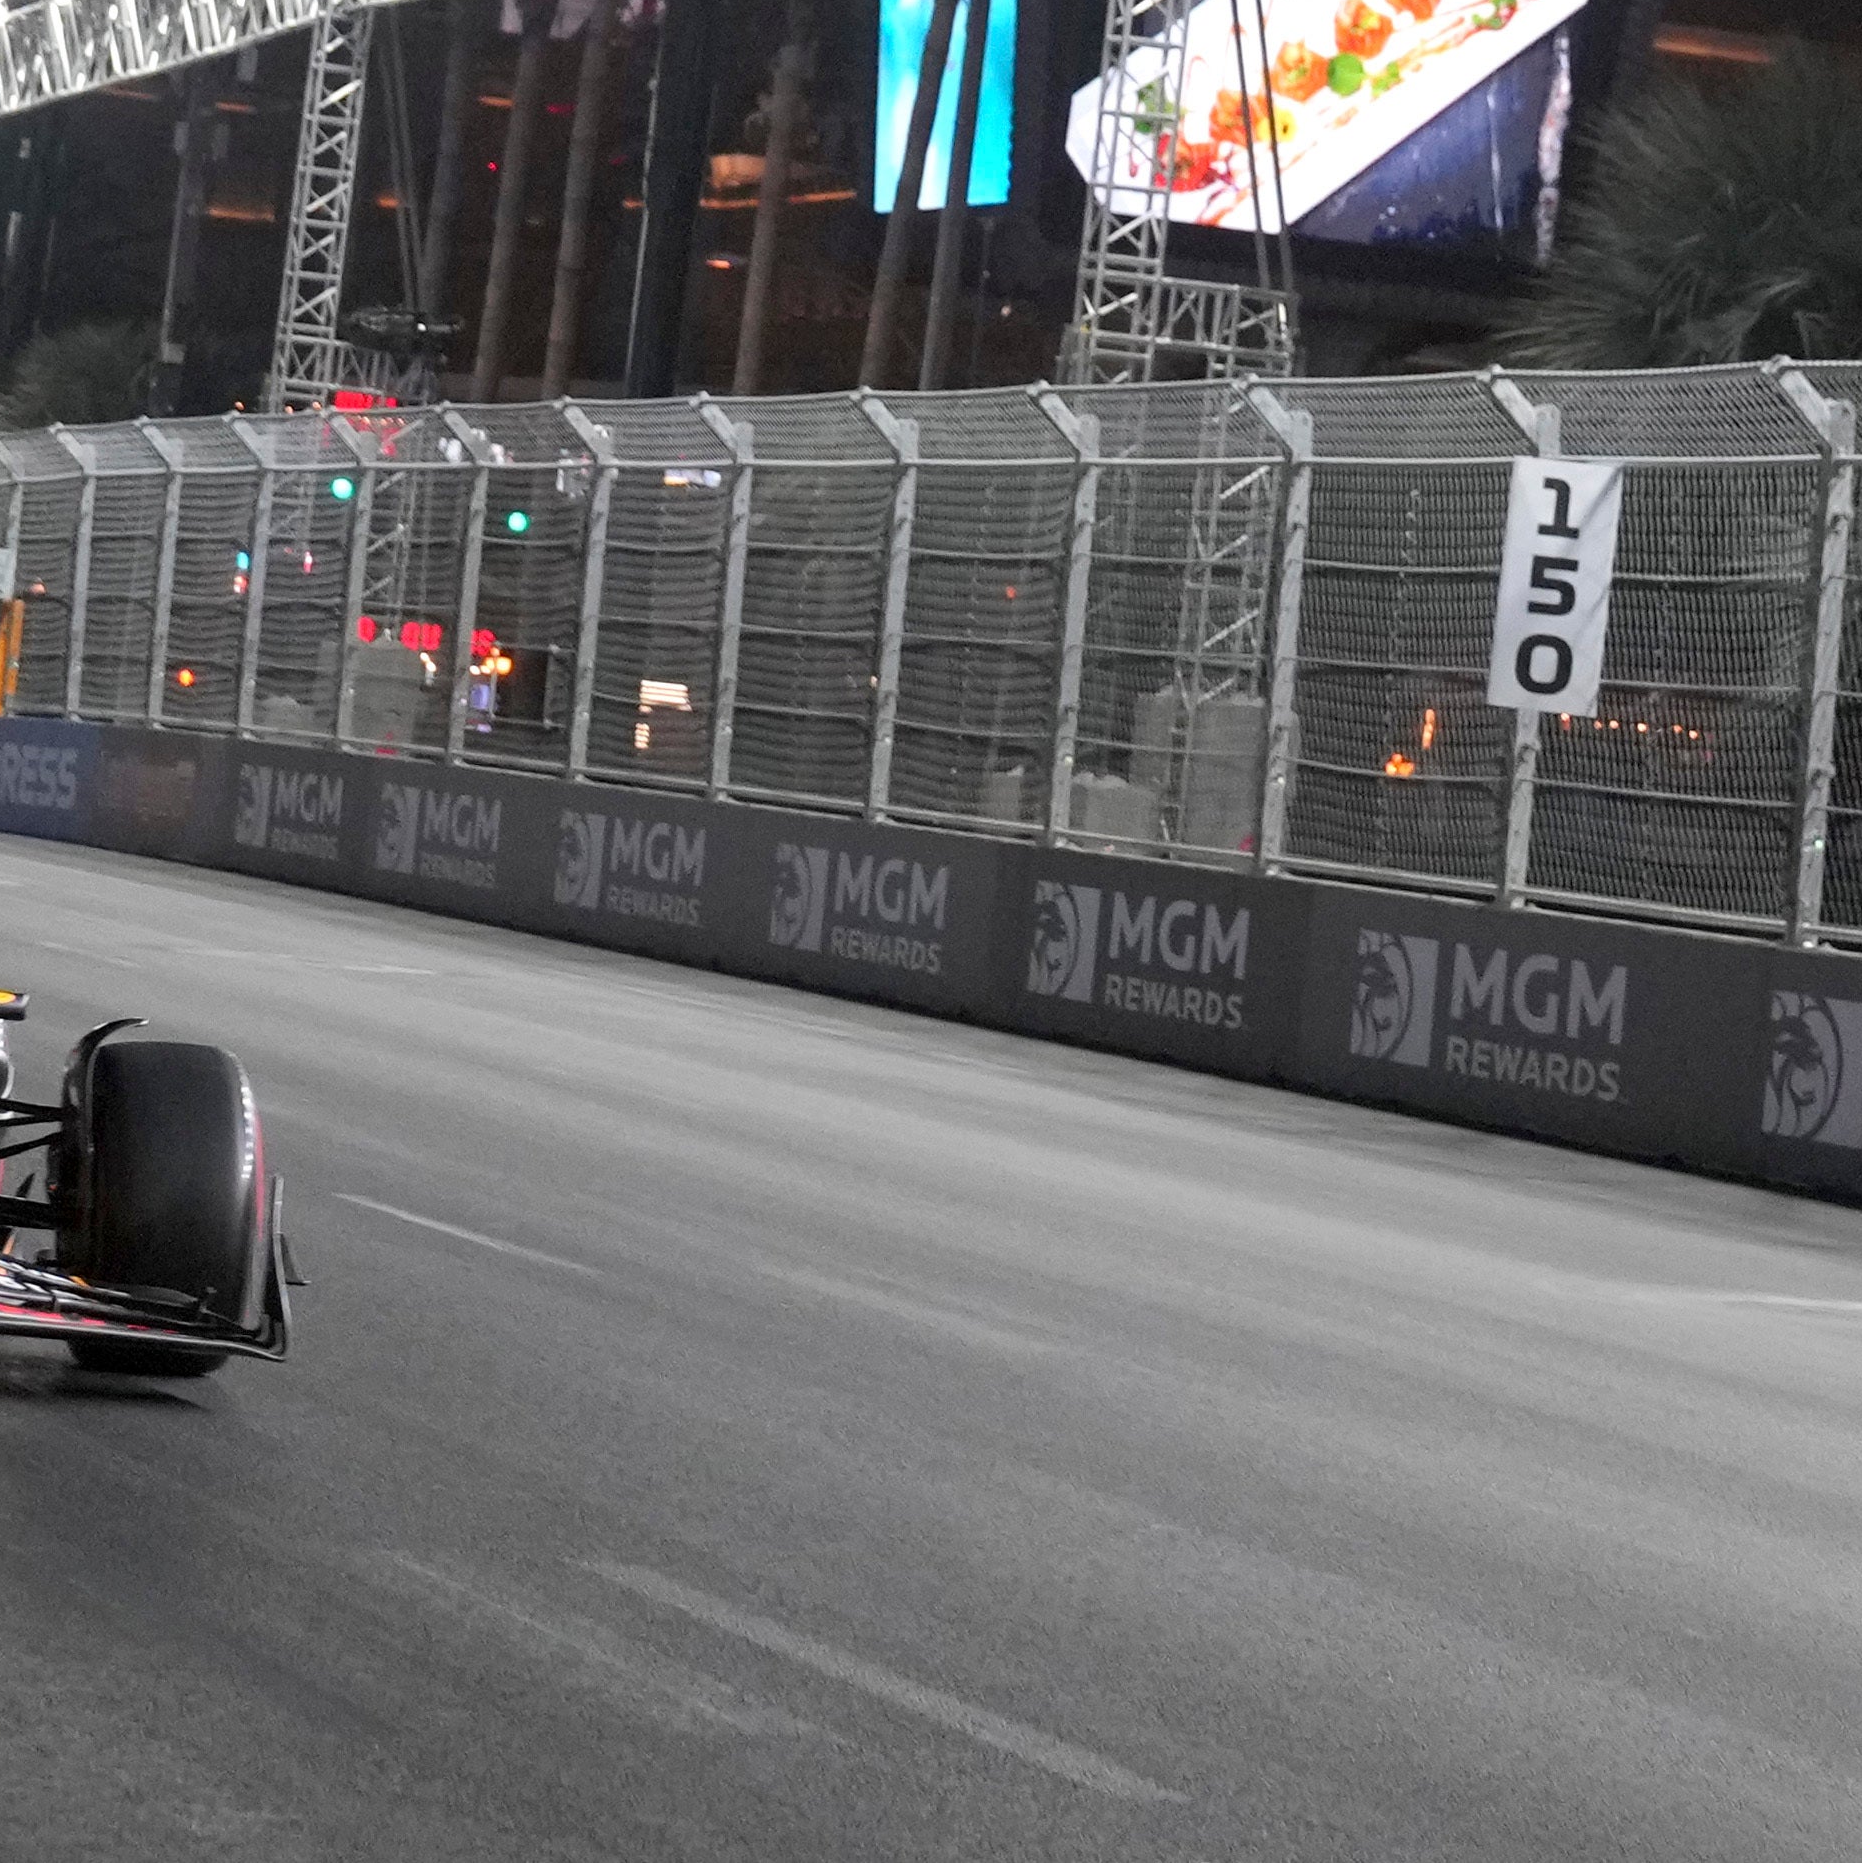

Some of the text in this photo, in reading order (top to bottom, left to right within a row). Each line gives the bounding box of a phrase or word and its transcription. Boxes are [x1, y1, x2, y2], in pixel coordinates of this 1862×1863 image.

[1514, 477, 1580, 695] 150
[272, 771, 343, 826] MGM
[423, 789, 500, 853] MGM
[610, 817, 706, 888] MGM
[603, 883, 701, 927] REWARDS
[832, 851, 947, 931] MGM
[827, 925, 942, 975] REWARDS
[1109, 891, 1251, 980] MGM
[1104, 972, 1243, 1029] REWARDS
[1452, 942, 1628, 1046] MGM
[1445, 1034, 1620, 1103] REWARDS
